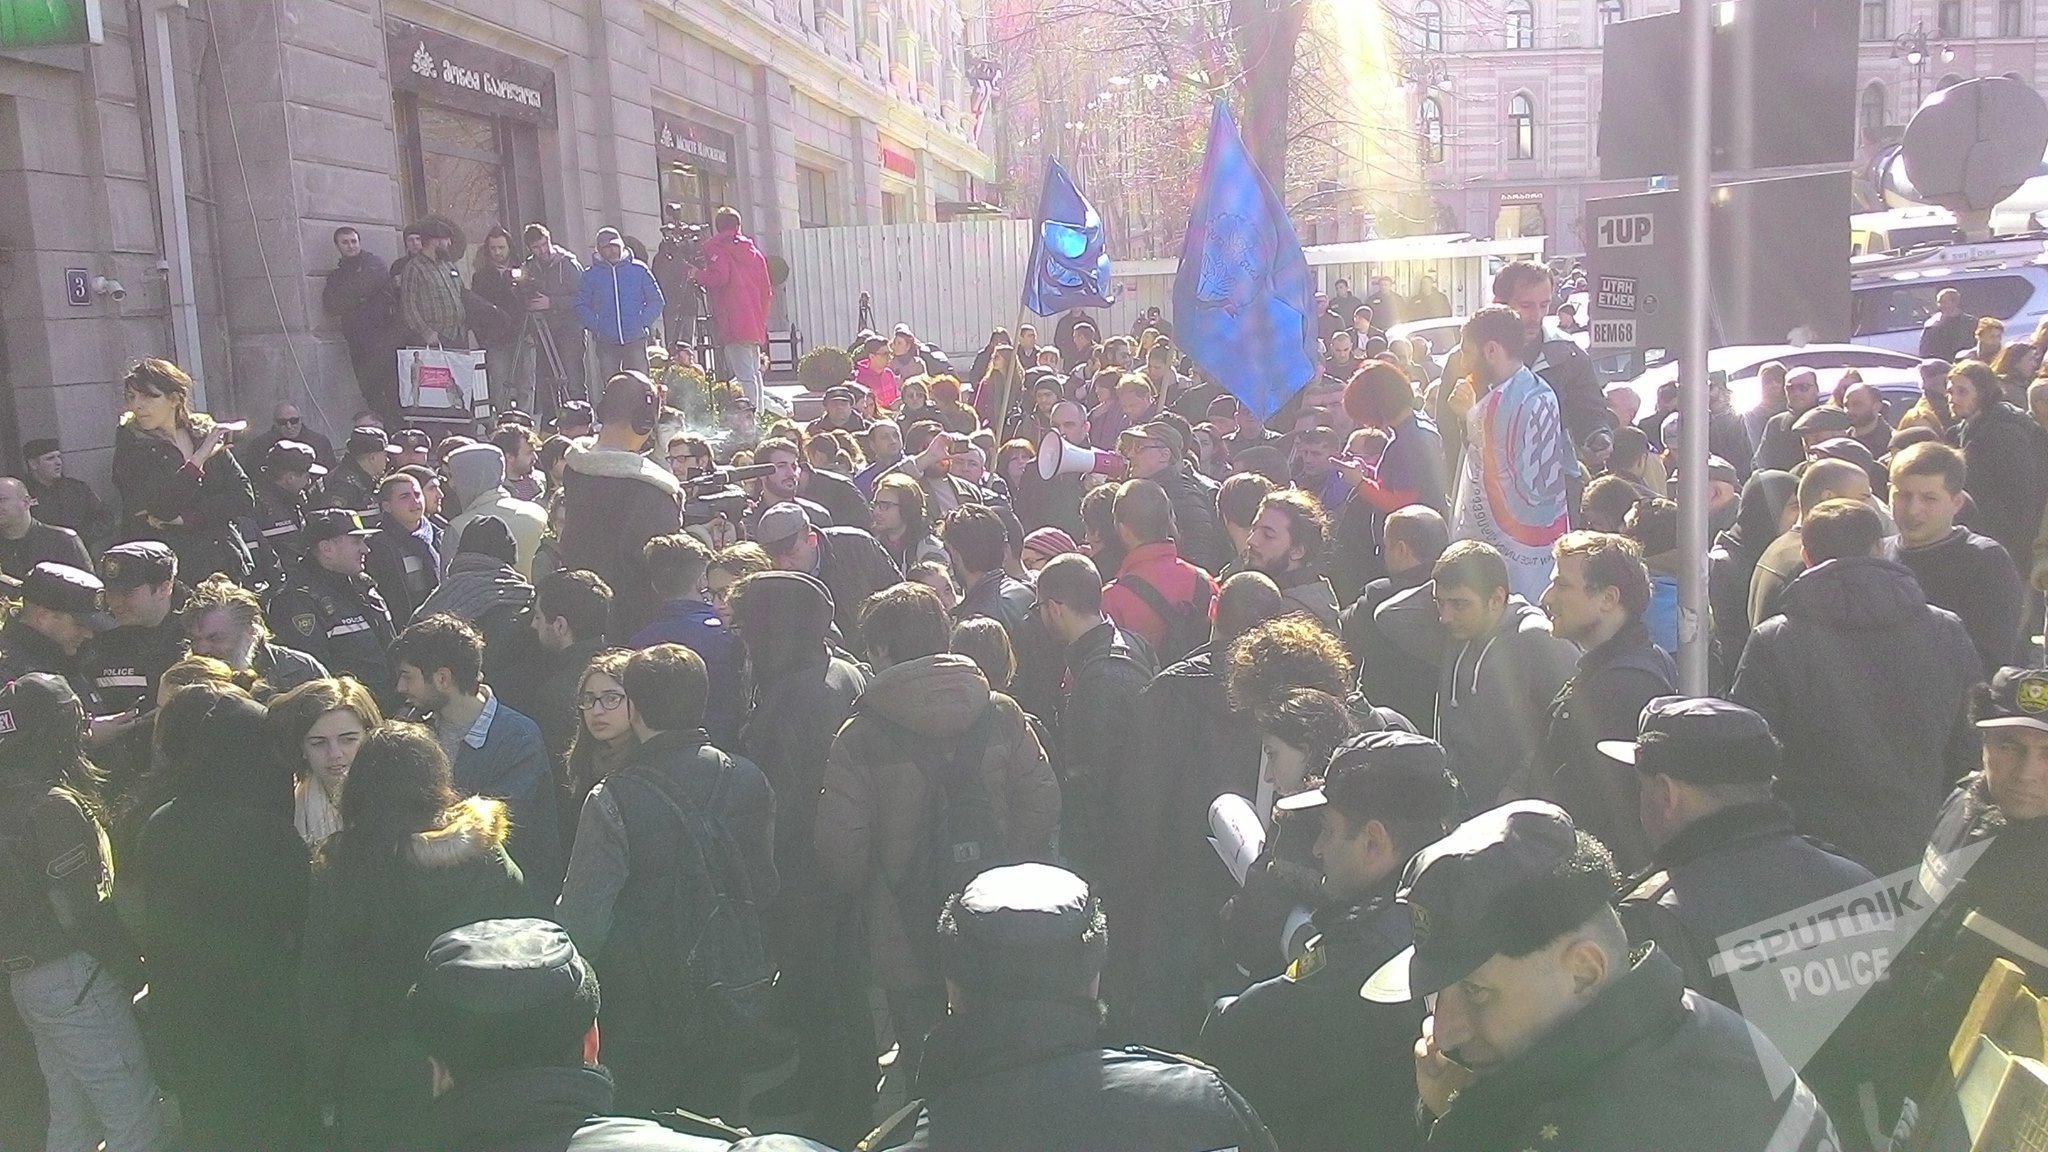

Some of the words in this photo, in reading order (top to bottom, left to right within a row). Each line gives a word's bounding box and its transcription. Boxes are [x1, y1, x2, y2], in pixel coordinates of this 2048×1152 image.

[1600, 216, 1652, 245] 1UP
[75, 276, 85, 298] 3
[1602, 279, 1634, 295] UTAH
[1598, 291, 1636, 308] ETHER
[1594, 322, 1633, 343] BEM68
[103, 667, 135, 676] POLICE
